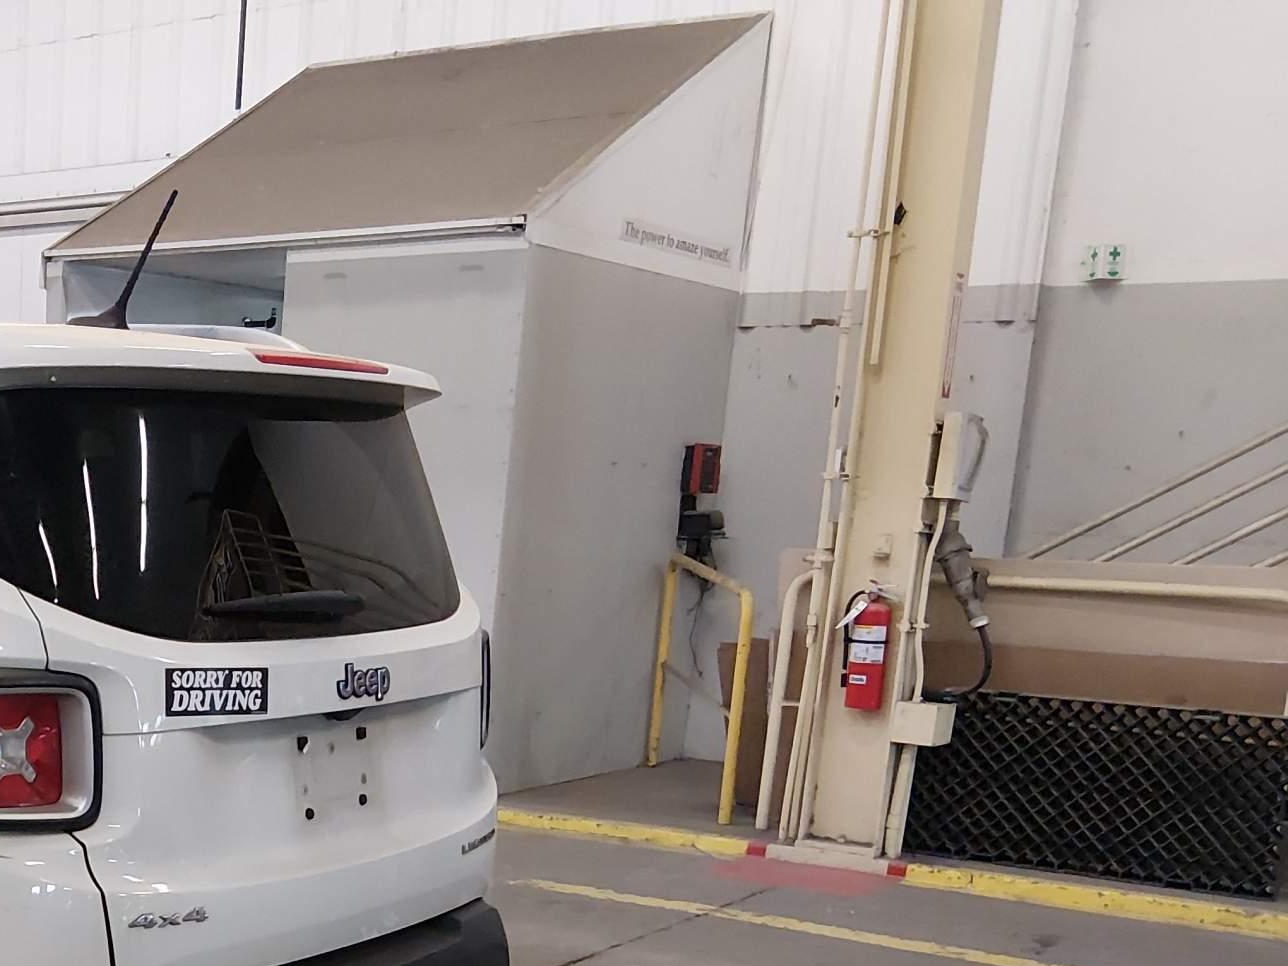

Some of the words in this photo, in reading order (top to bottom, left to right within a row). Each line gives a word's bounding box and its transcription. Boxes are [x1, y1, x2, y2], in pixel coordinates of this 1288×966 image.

[624, 221, 640, 239] The
[640, 230, 666, 246] power
[666, 234, 675, 249] to
[675, 239, 699, 255] amaze
[171, 669, 230, 689] SORRY
[230, 669, 263, 689] FOR
[336, 663, 390, 700] Jeep
[170, 689, 262, 712] DRIVING
[127, 905, 209, 929] 4x4
